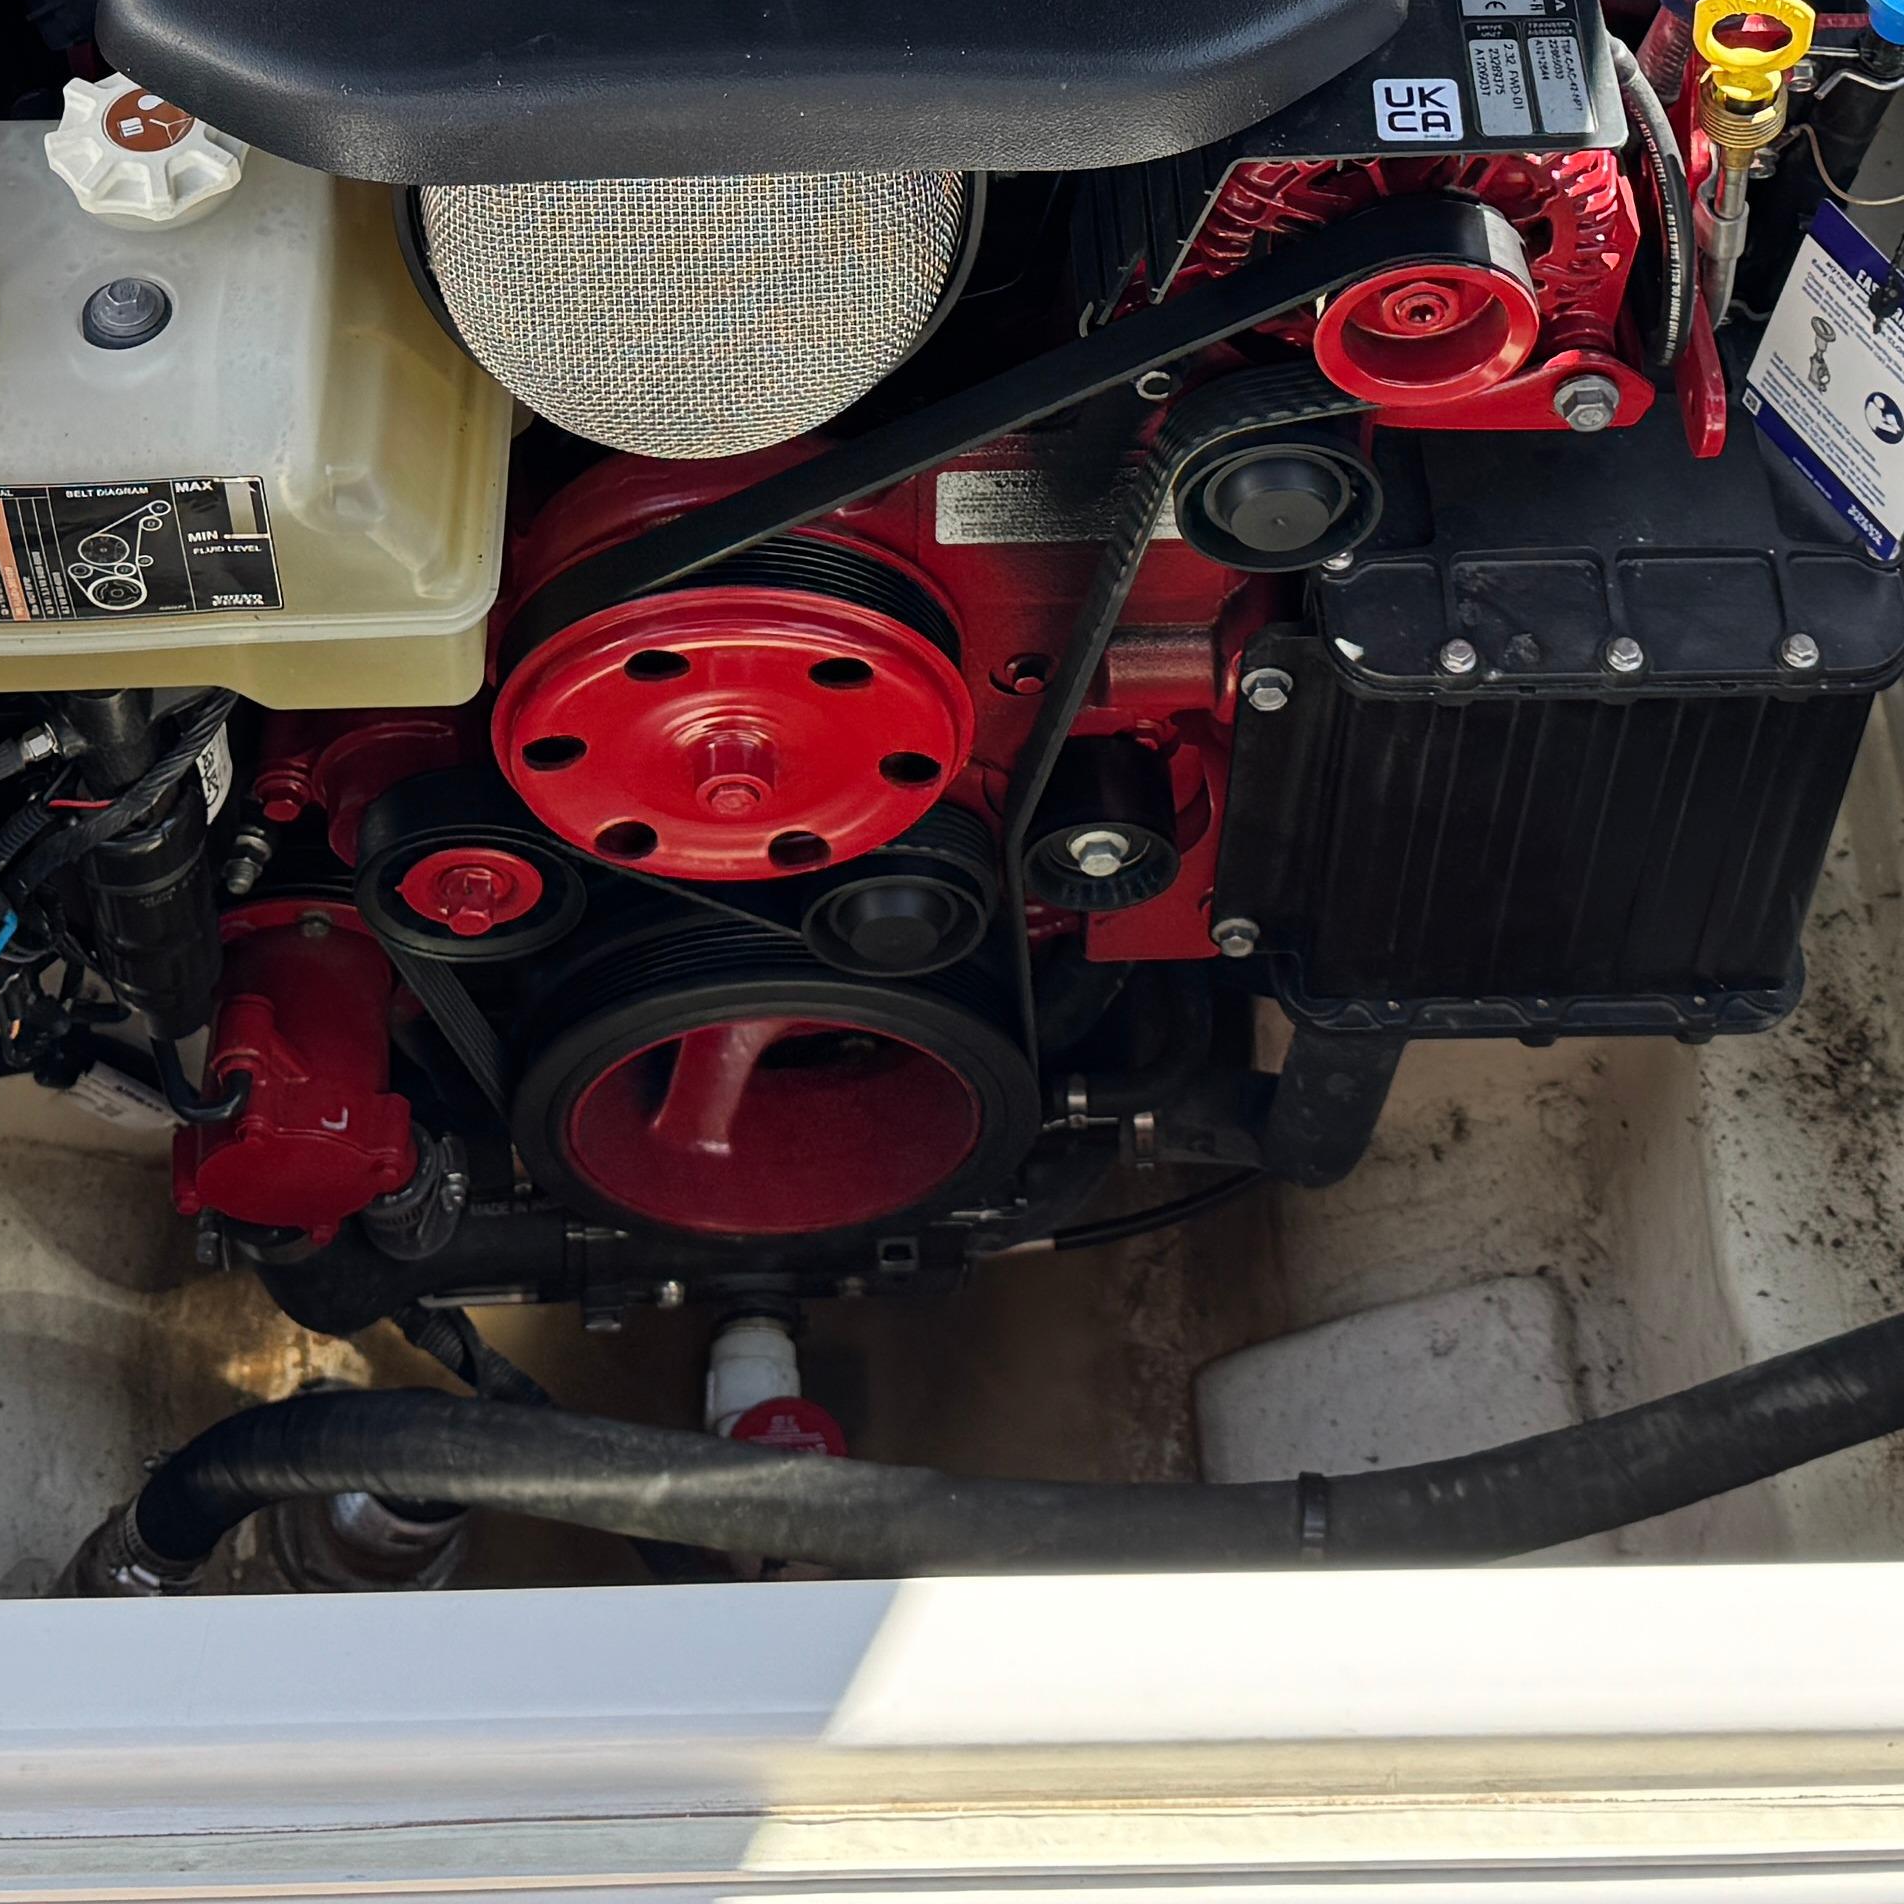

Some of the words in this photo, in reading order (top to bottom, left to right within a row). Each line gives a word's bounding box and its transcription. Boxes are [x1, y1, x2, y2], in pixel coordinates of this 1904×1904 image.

[1384, 87, 1448, 108] UK
[1388, 111, 1451, 132] CA
[66, 489, 93, 498] BELT
[97, 486, 149, 497] DIAGRAM
[175, 481, 214, 494] MAX
[188, 531, 218, 542] MIN
[194, 546, 224, 555] FLUID
[228, 544, 262, 553] LEVEL
